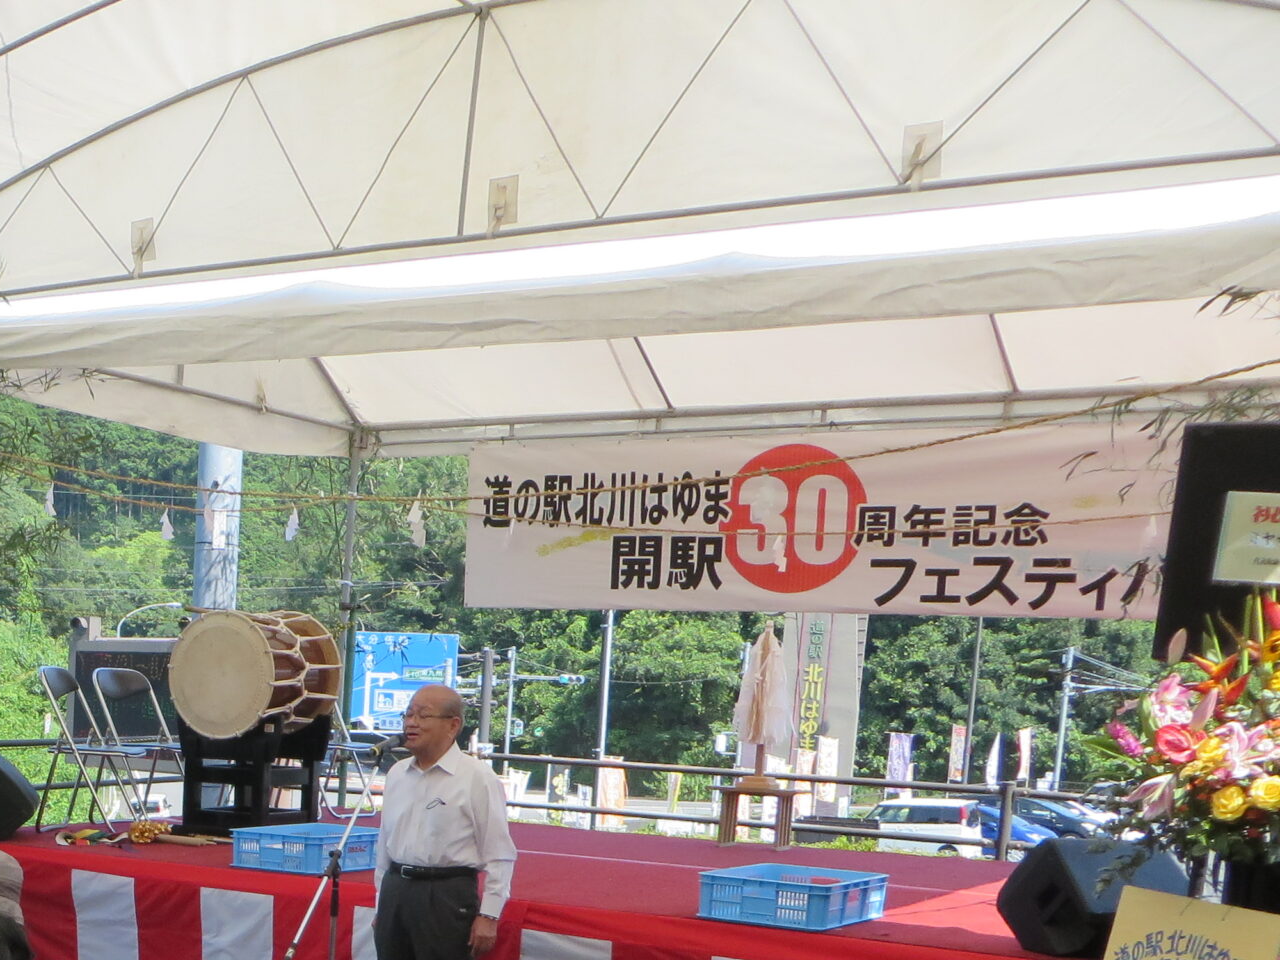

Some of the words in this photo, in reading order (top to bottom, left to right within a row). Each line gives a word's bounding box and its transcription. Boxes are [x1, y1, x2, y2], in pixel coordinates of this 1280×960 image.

[483, 471, 730, 528] 道の駅北川はゆま
[736, 474, 848, 566] 30
[854, 502, 1051, 547] 周年記念
[610, 536, 724, 590] 開駅
[808, 620, 824, 659] 道の駅
